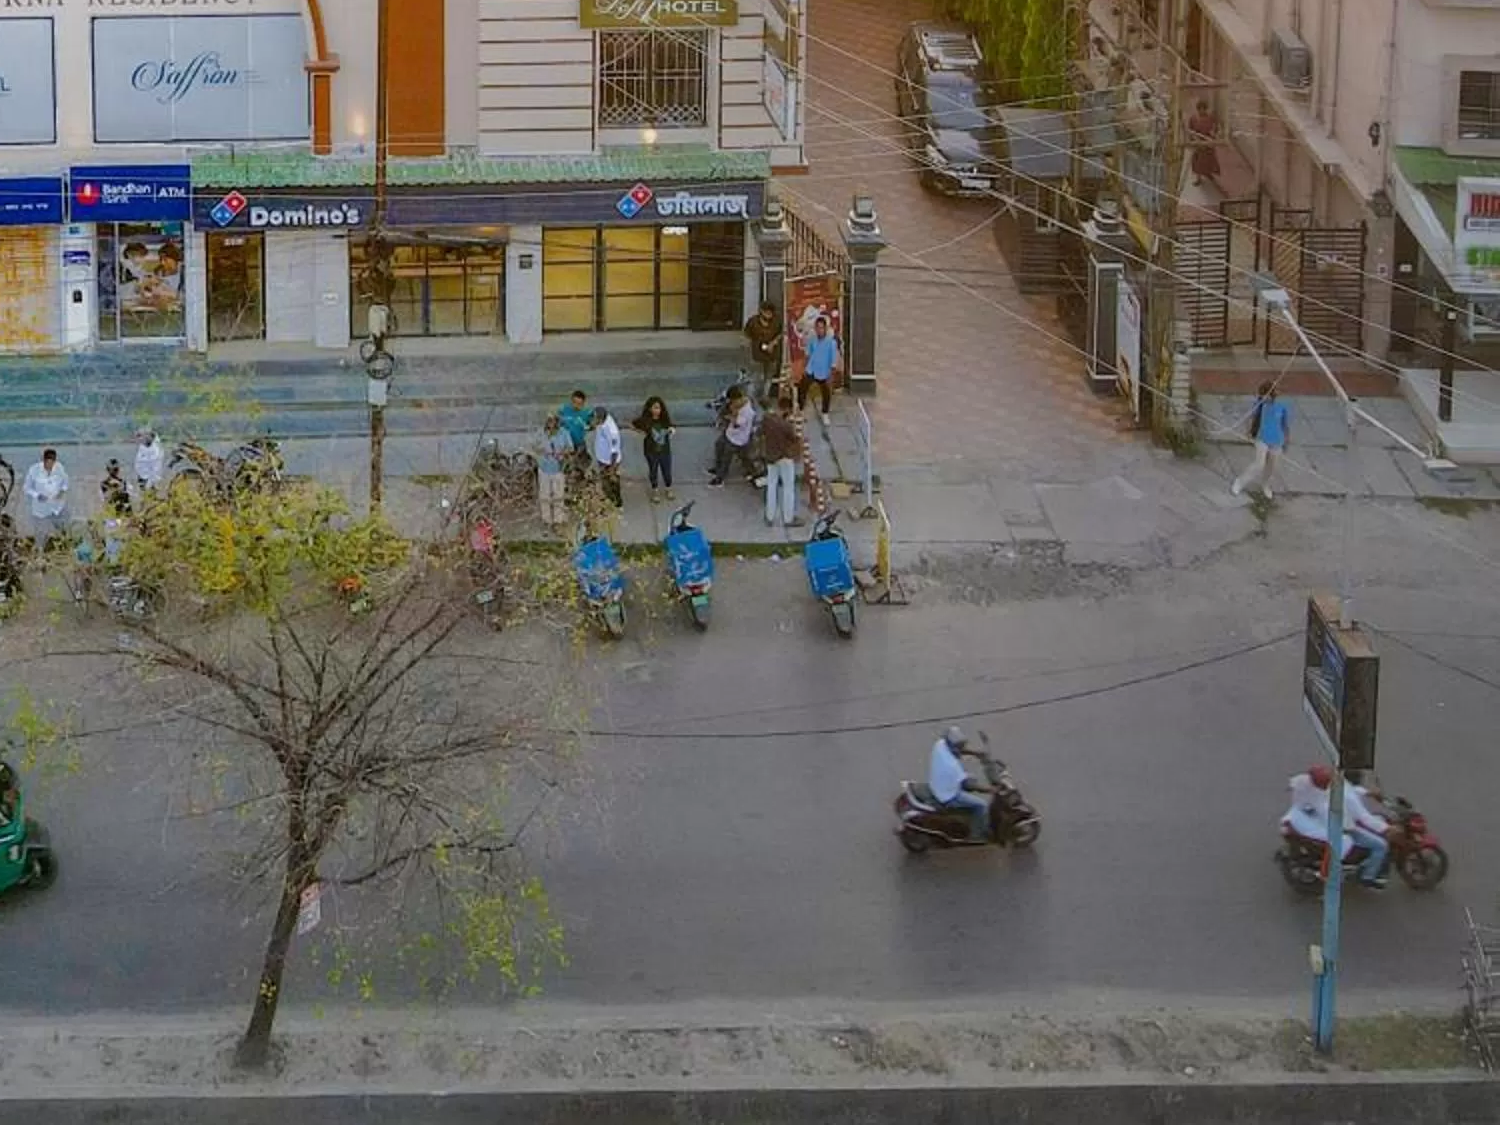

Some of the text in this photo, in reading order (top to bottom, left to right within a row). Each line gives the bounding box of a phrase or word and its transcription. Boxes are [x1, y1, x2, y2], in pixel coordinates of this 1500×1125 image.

[657, 0, 727, 13] HOTEL
[131, 50, 238, 105] Saffron
[101, 182, 152, 194] Bandhan
[158, 186, 187, 198] ATM
[250, 203, 361, 226] Domino's
